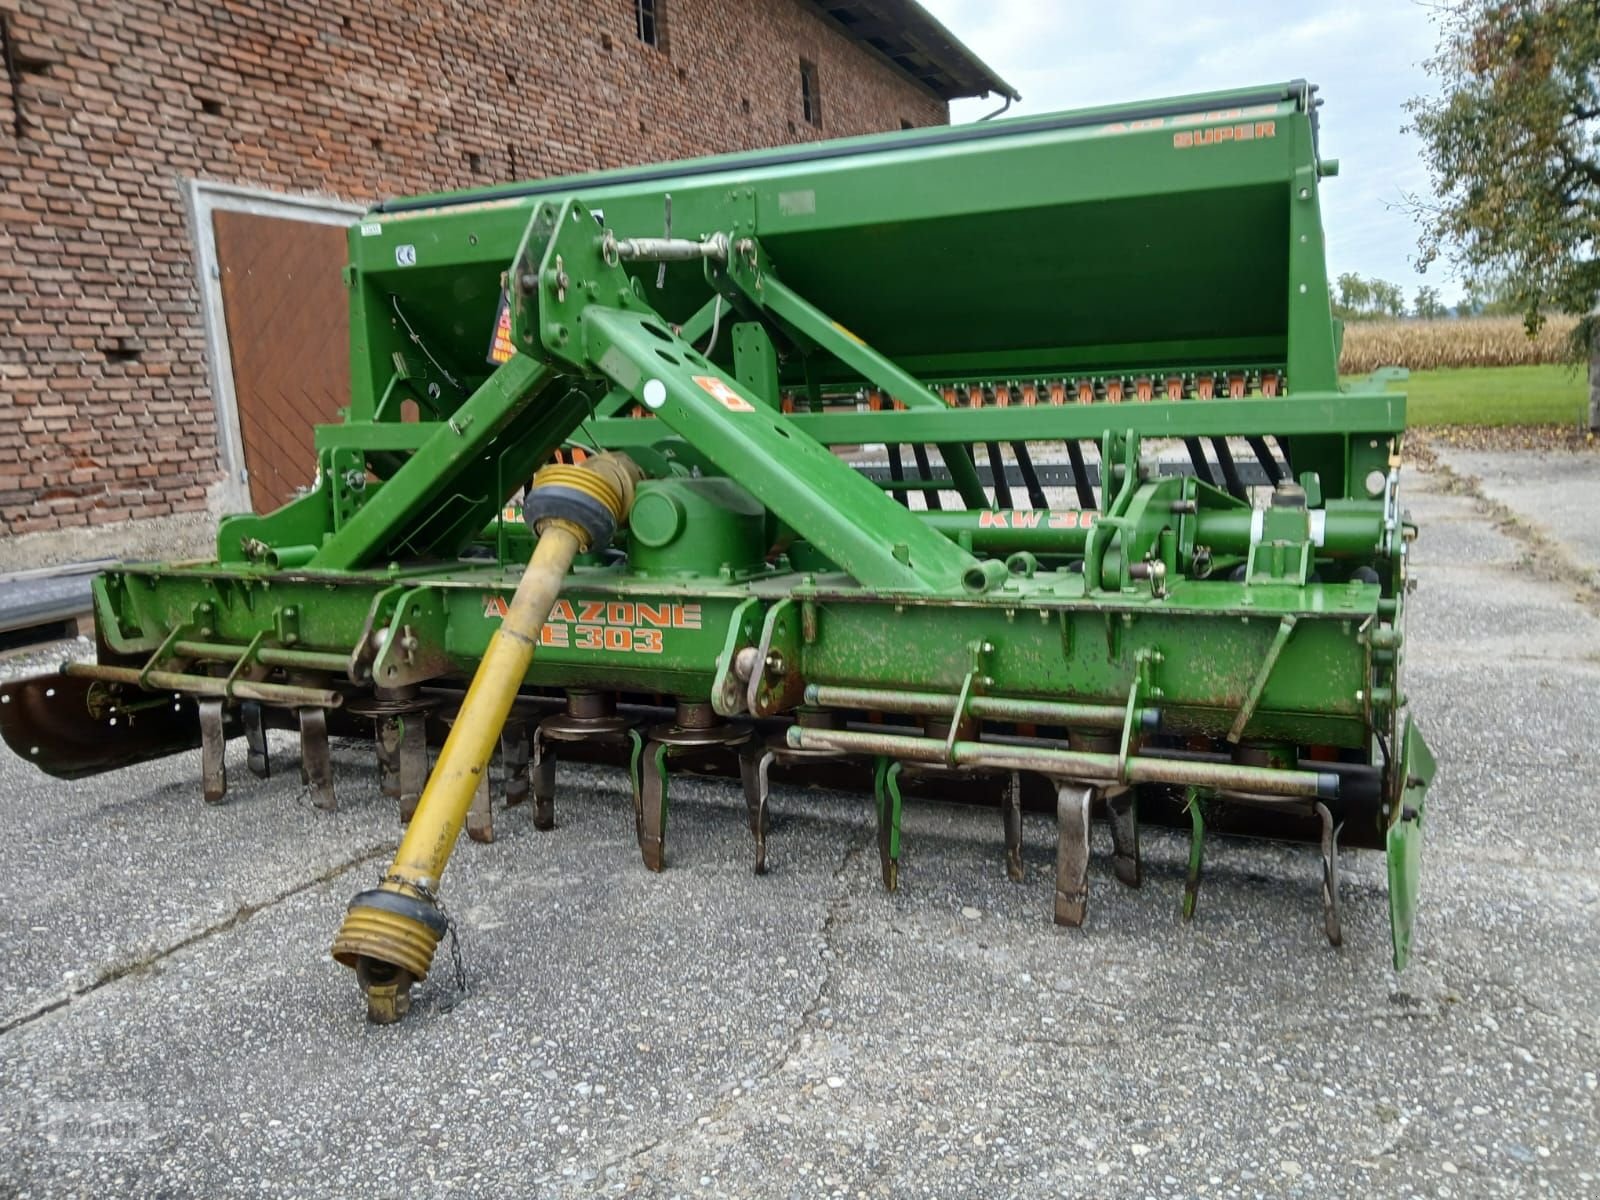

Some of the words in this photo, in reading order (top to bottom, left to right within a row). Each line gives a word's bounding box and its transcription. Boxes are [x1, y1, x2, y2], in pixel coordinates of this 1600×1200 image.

[1173, 121, 1276, 149] SUPER
[979, 510, 1043, 528] KW
[484, 595, 702, 629] AAZONE
[535, 623, 570, 648] E
[574, 625, 664, 654] 303
